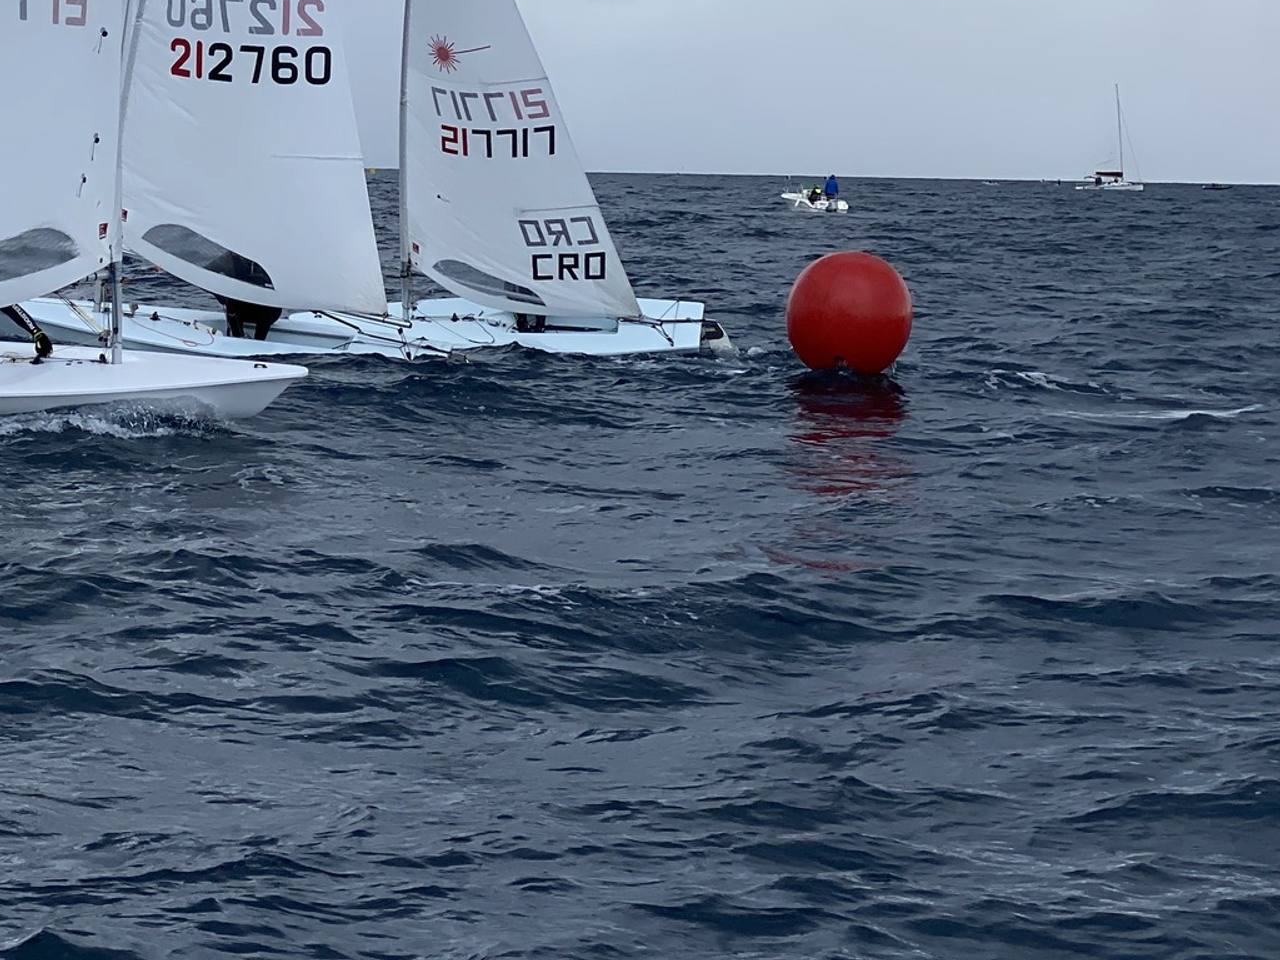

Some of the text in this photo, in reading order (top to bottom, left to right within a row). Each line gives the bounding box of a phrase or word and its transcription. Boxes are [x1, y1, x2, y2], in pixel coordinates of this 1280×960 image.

[170, 38, 332, 85] 212760
[440, 124, 556, 158] 217717
[532, 252, 606, 280] CRO
